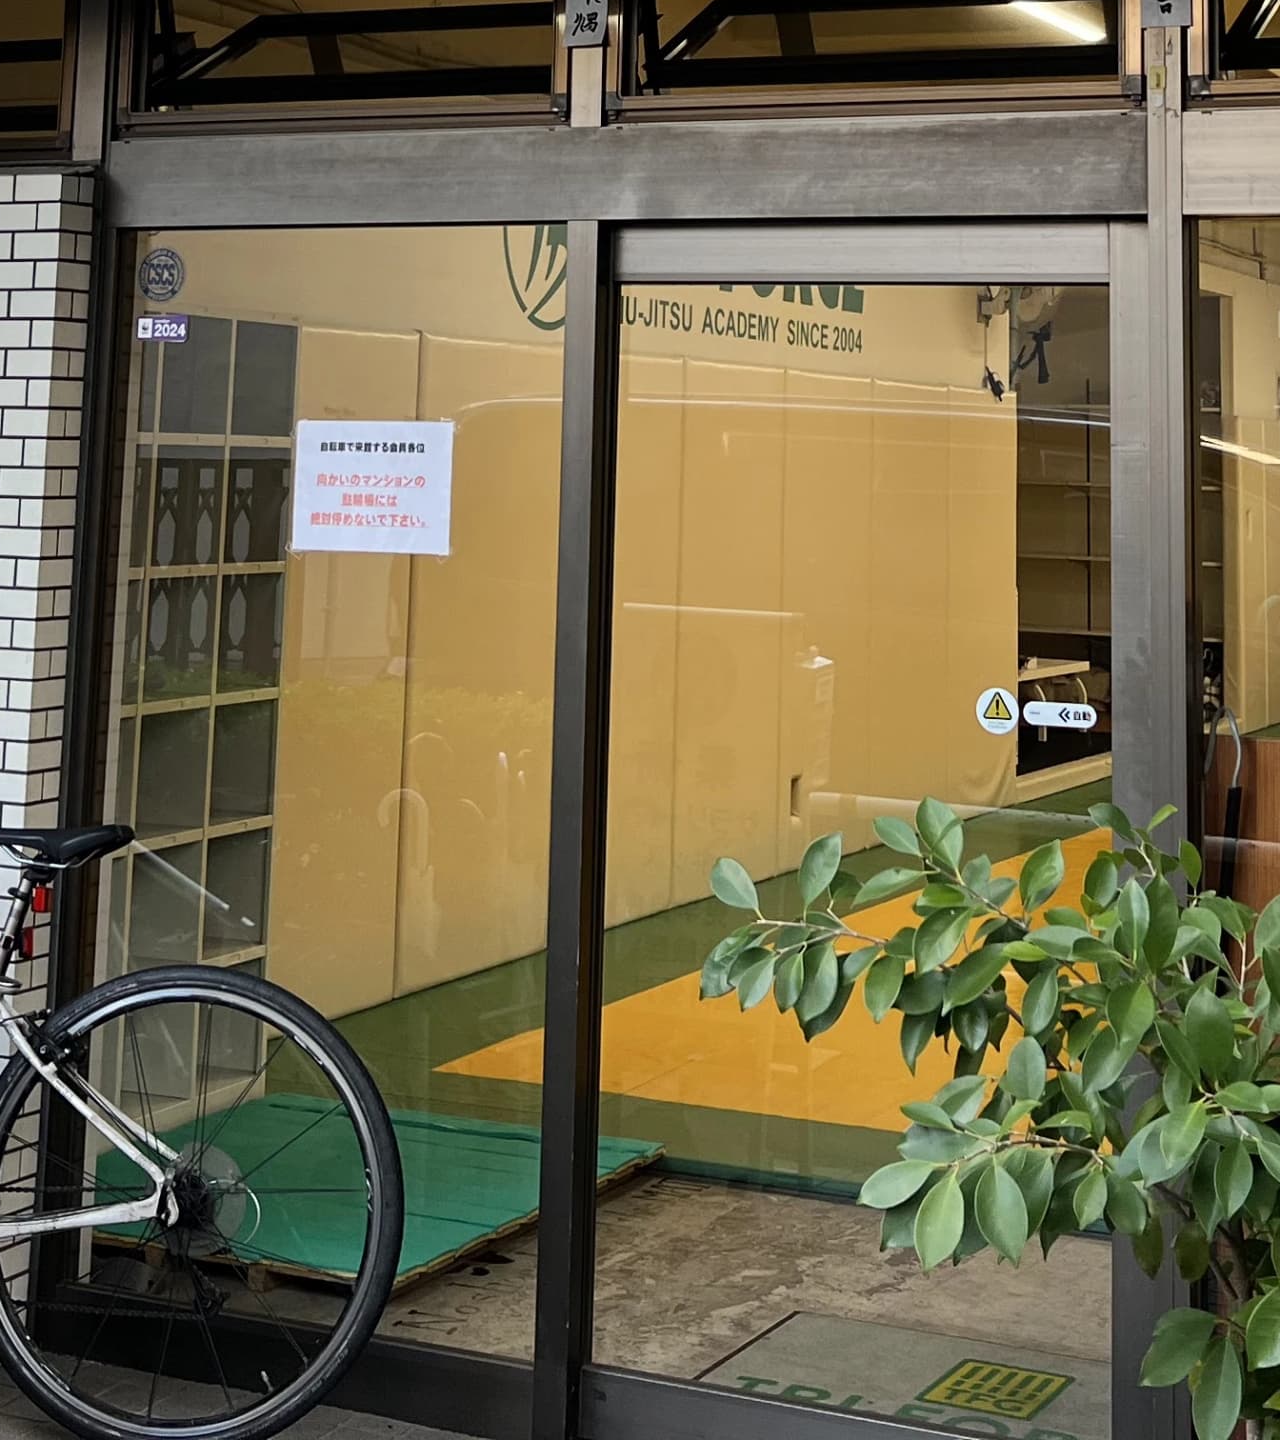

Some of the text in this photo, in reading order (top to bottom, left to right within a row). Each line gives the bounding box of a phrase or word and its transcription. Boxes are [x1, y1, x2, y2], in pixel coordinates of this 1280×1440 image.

[153, 323, 186, 337] 2024
[620, 295, 693, 333] IU-JITSU
[701, 306, 780, 344] ACADEMY
[786, 319, 829, 350] SINCE
[832, 326, 863, 354] 2004
